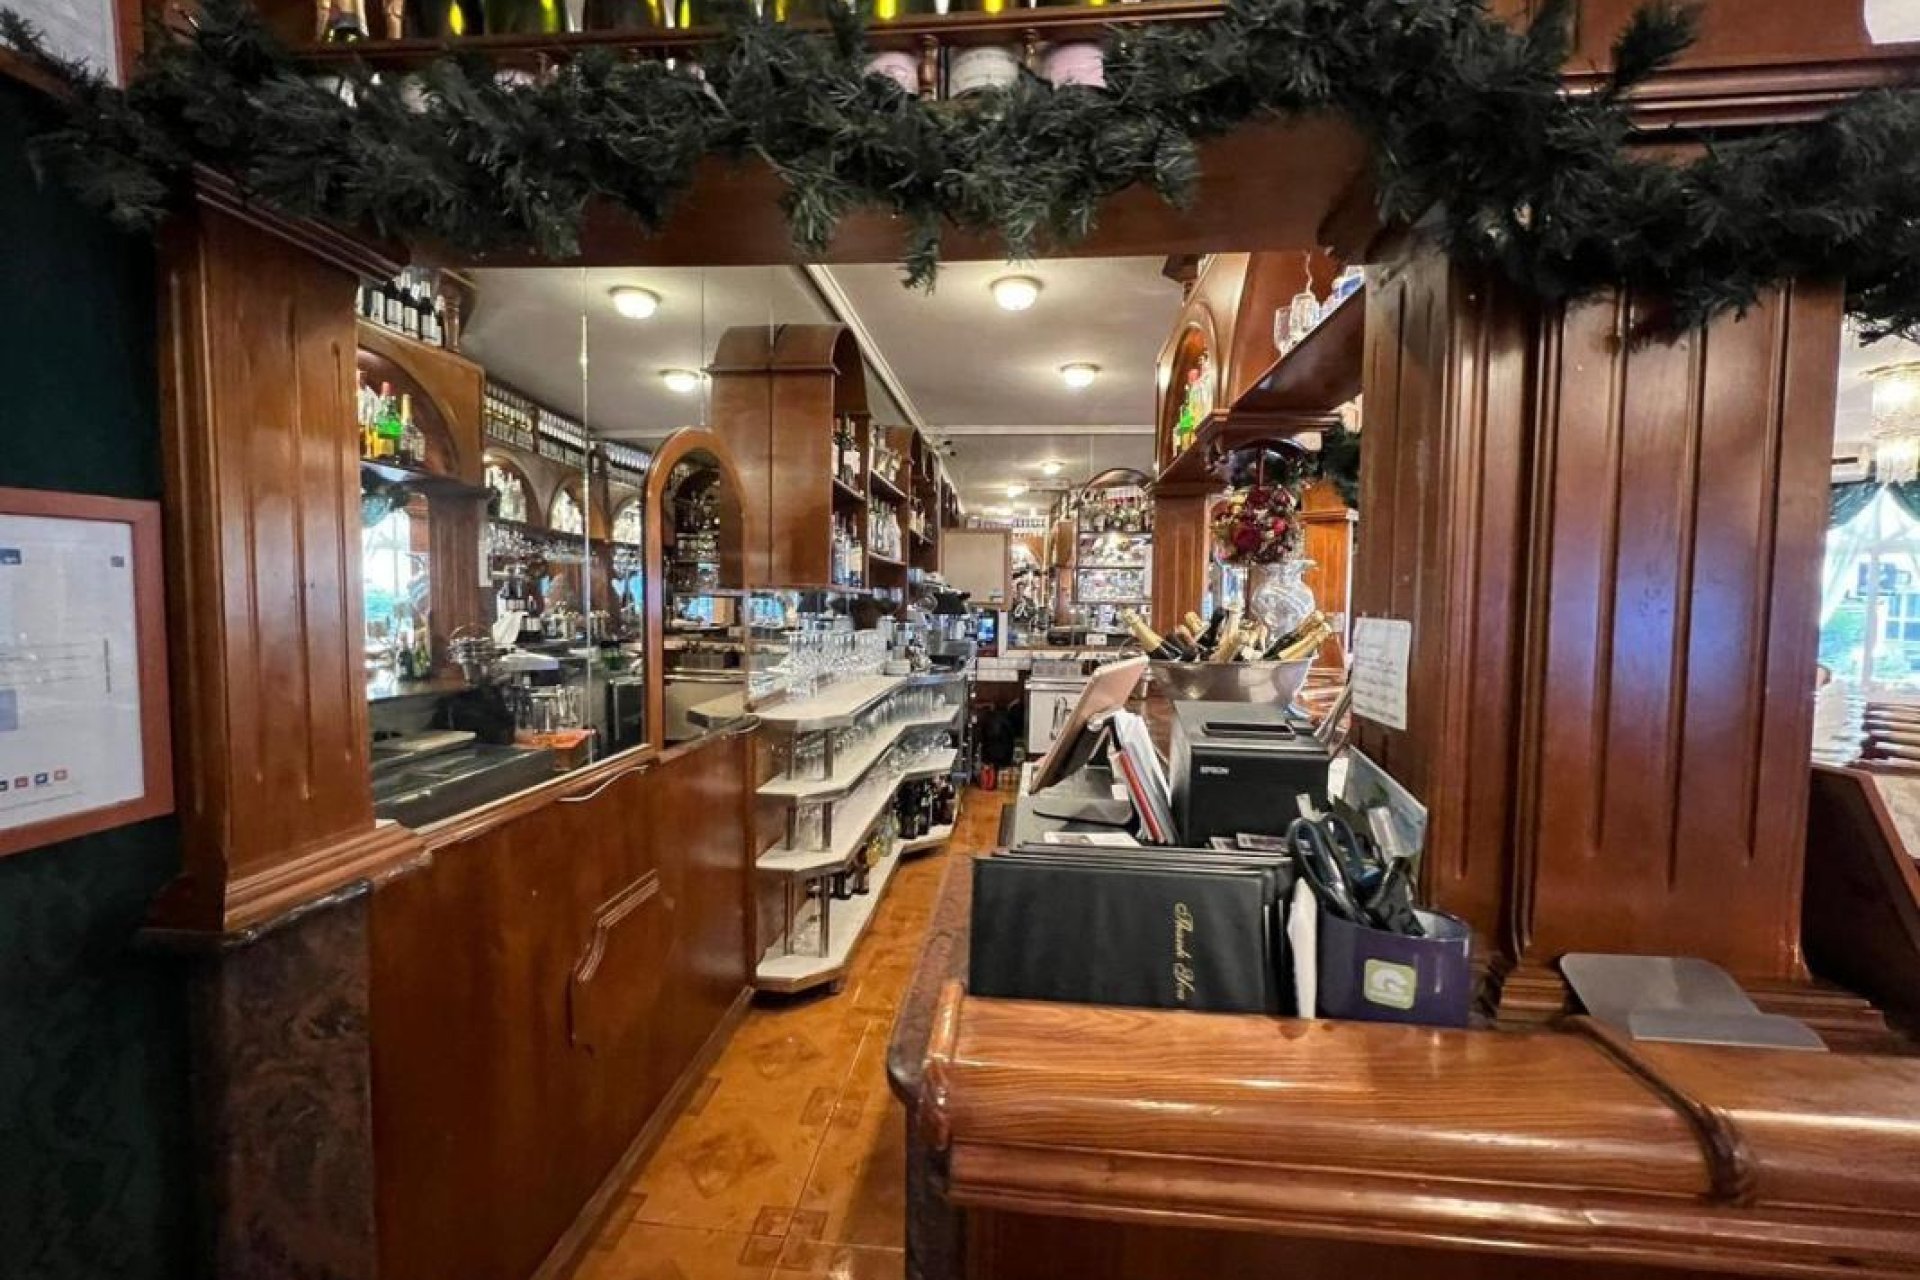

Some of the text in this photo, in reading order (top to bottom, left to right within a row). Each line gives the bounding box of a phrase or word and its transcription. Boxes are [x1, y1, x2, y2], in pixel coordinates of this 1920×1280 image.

[1200, 766, 1229, 775] EPSON
[1173, 903, 1195, 1000] Thank You
